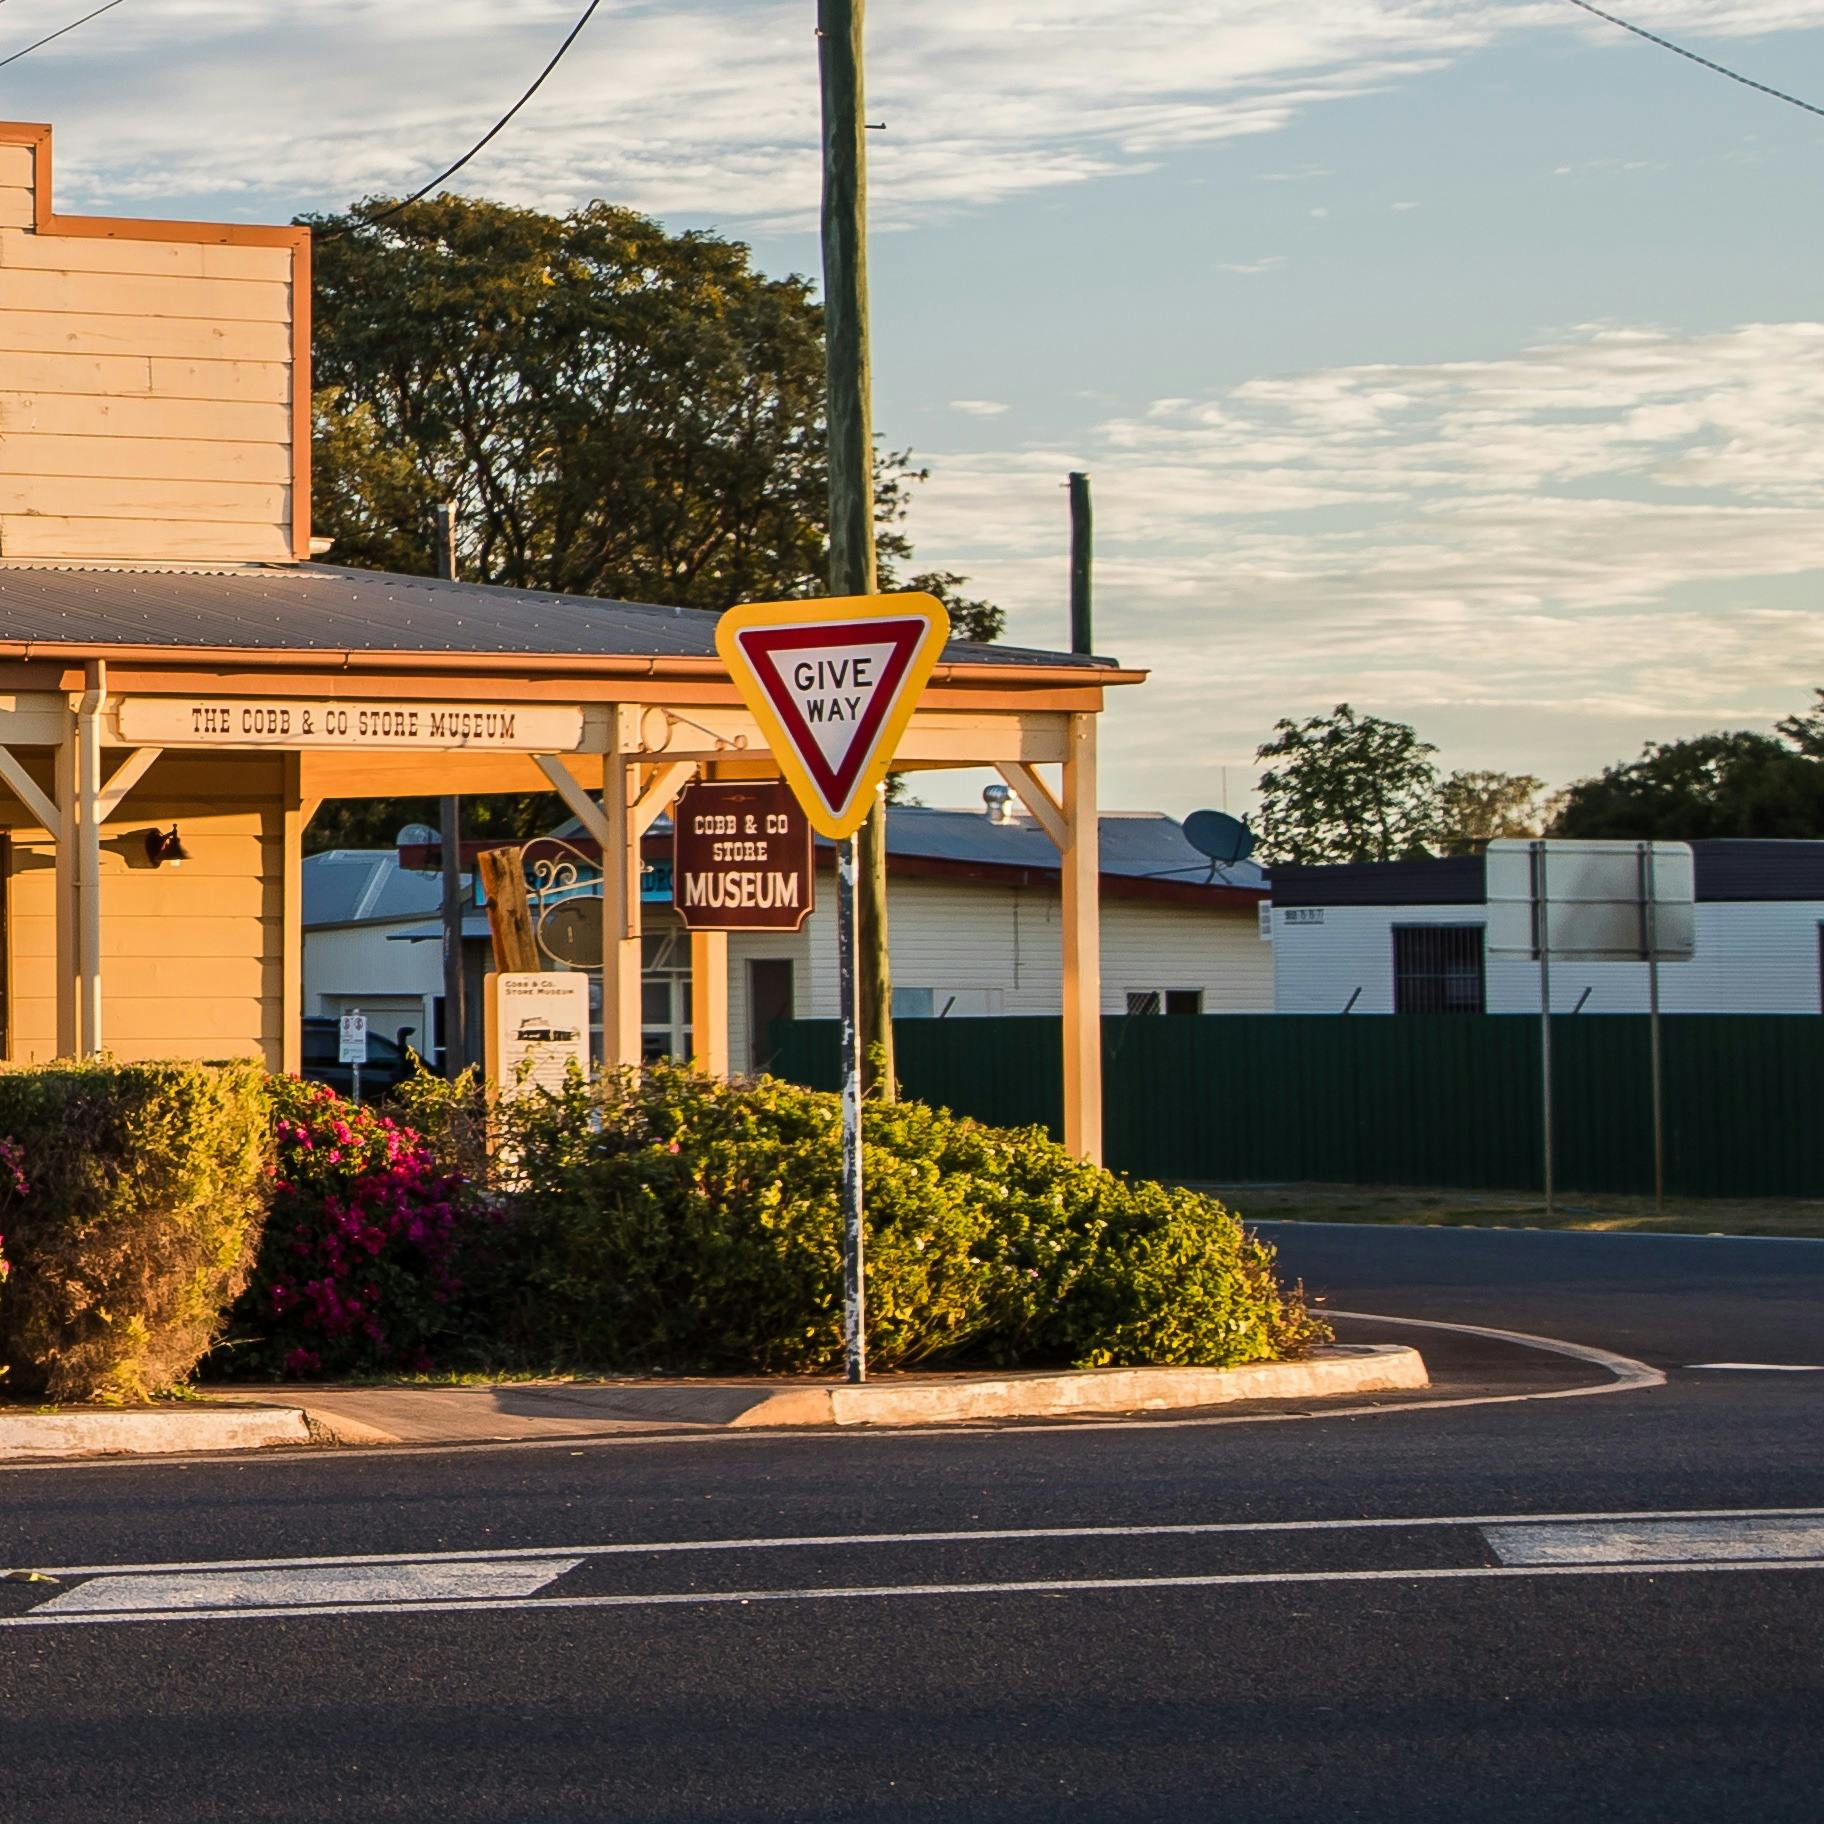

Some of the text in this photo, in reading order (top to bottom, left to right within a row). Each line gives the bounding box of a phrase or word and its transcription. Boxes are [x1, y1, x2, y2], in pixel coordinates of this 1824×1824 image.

[794, 658, 873, 691] GIVE
[192, 708, 515, 738] THE COBB & CO STORE MUSEUM
[806, 697, 861, 722] WAY
[694, 814, 788, 835] COBB & CO
[713, 841, 767, 861] STORE
[684, 871, 799, 908] MUSEUM
